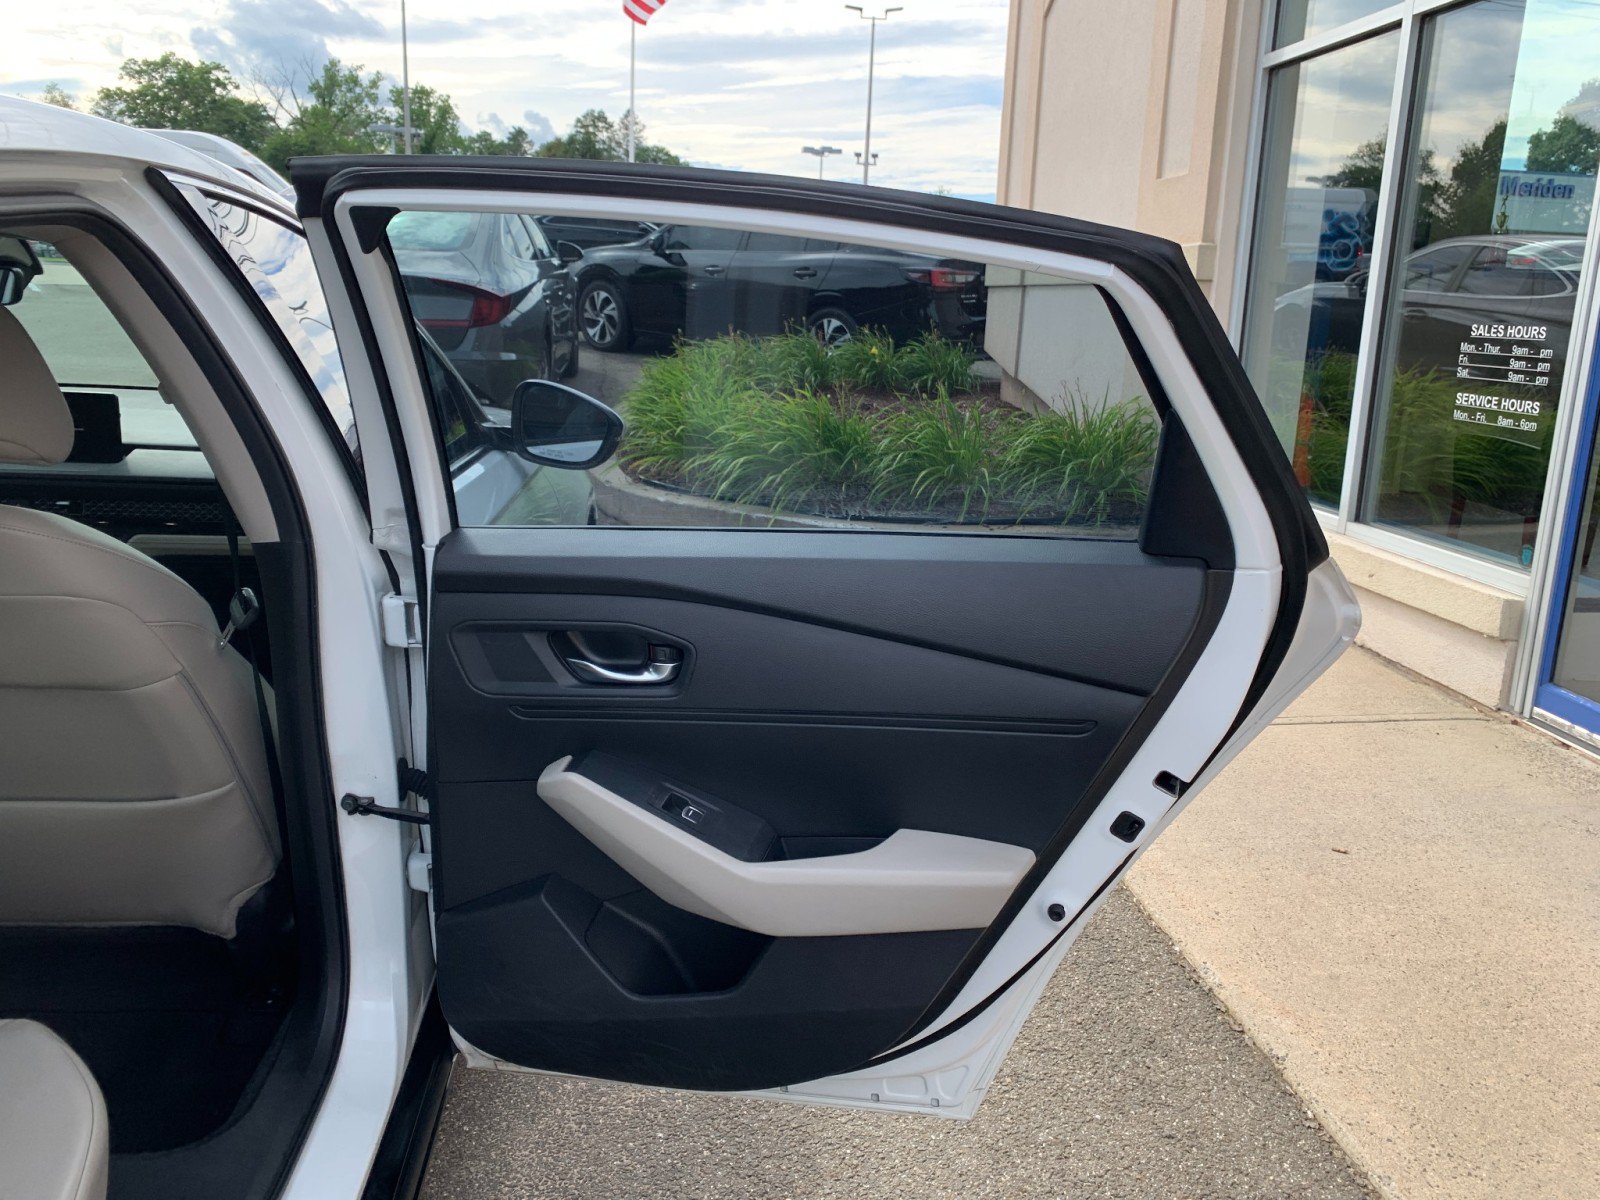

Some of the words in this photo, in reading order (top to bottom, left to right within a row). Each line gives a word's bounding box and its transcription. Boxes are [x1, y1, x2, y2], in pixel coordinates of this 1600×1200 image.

[1499, 175, 1576, 199] Meriden
[1470, 324, 1504, 337] SALES
[1507, 325, 1546, 339] HOURS
[1460, 342, 1476, 352] Mon.
[1484, 343, 1501, 354] Thur.
[1512, 345, 1528, 355] 9am
[1540, 349, 1553, 358] pm
[1458, 354, 1470, 364] Fri.
[1510, 358, 1526, 368] 9am
[1537, 362, 1550, 372] pm
[1456, 367, 1470, 378] Sat.
[1508, 372, 1524, 382] 9am
[1536, 376, 1548, 386] pm
[1455, 392, 1500, 409] SERVICE
[1500, 398, 1540, 414] HOURS
[1453, 410, 1470, 420] Mon.
[1476, 412, 1487, 424] Fri.
[1496, 416, 1514, 427] 8am
[1520, 418, 1537, 431] 6pm
